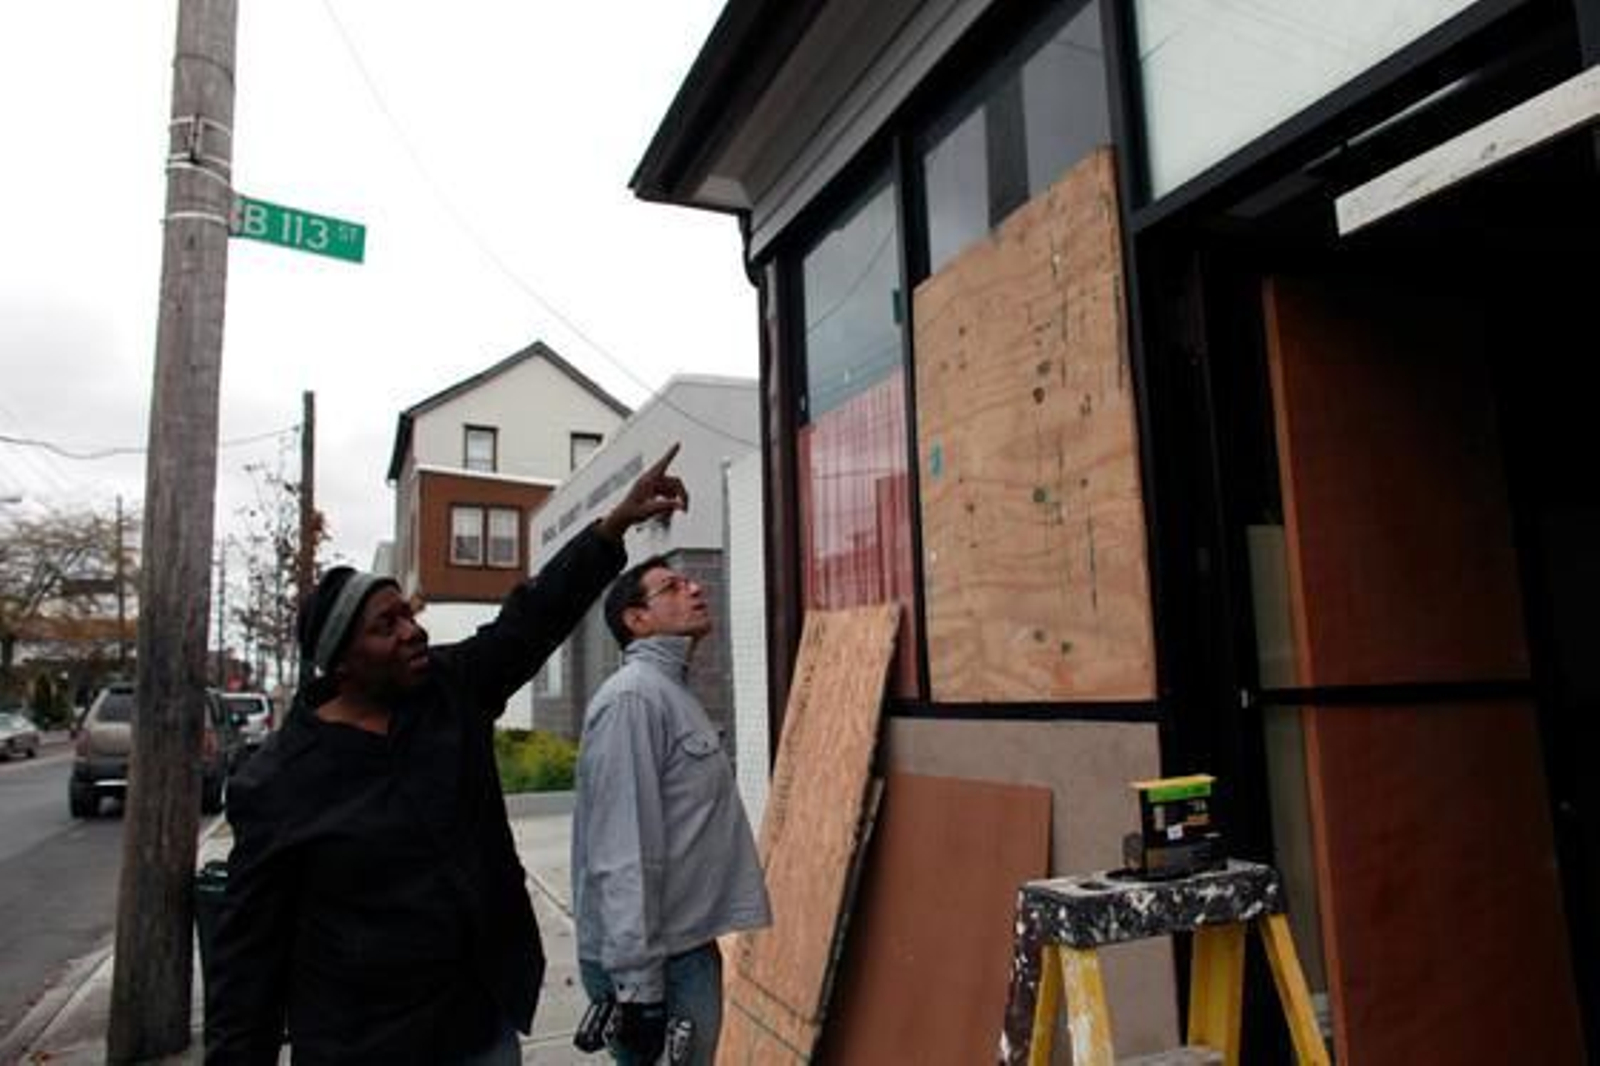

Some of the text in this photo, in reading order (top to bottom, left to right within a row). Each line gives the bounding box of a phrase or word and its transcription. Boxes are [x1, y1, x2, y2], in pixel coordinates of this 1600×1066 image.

[244, 203, 358, 250] B 113 ST
